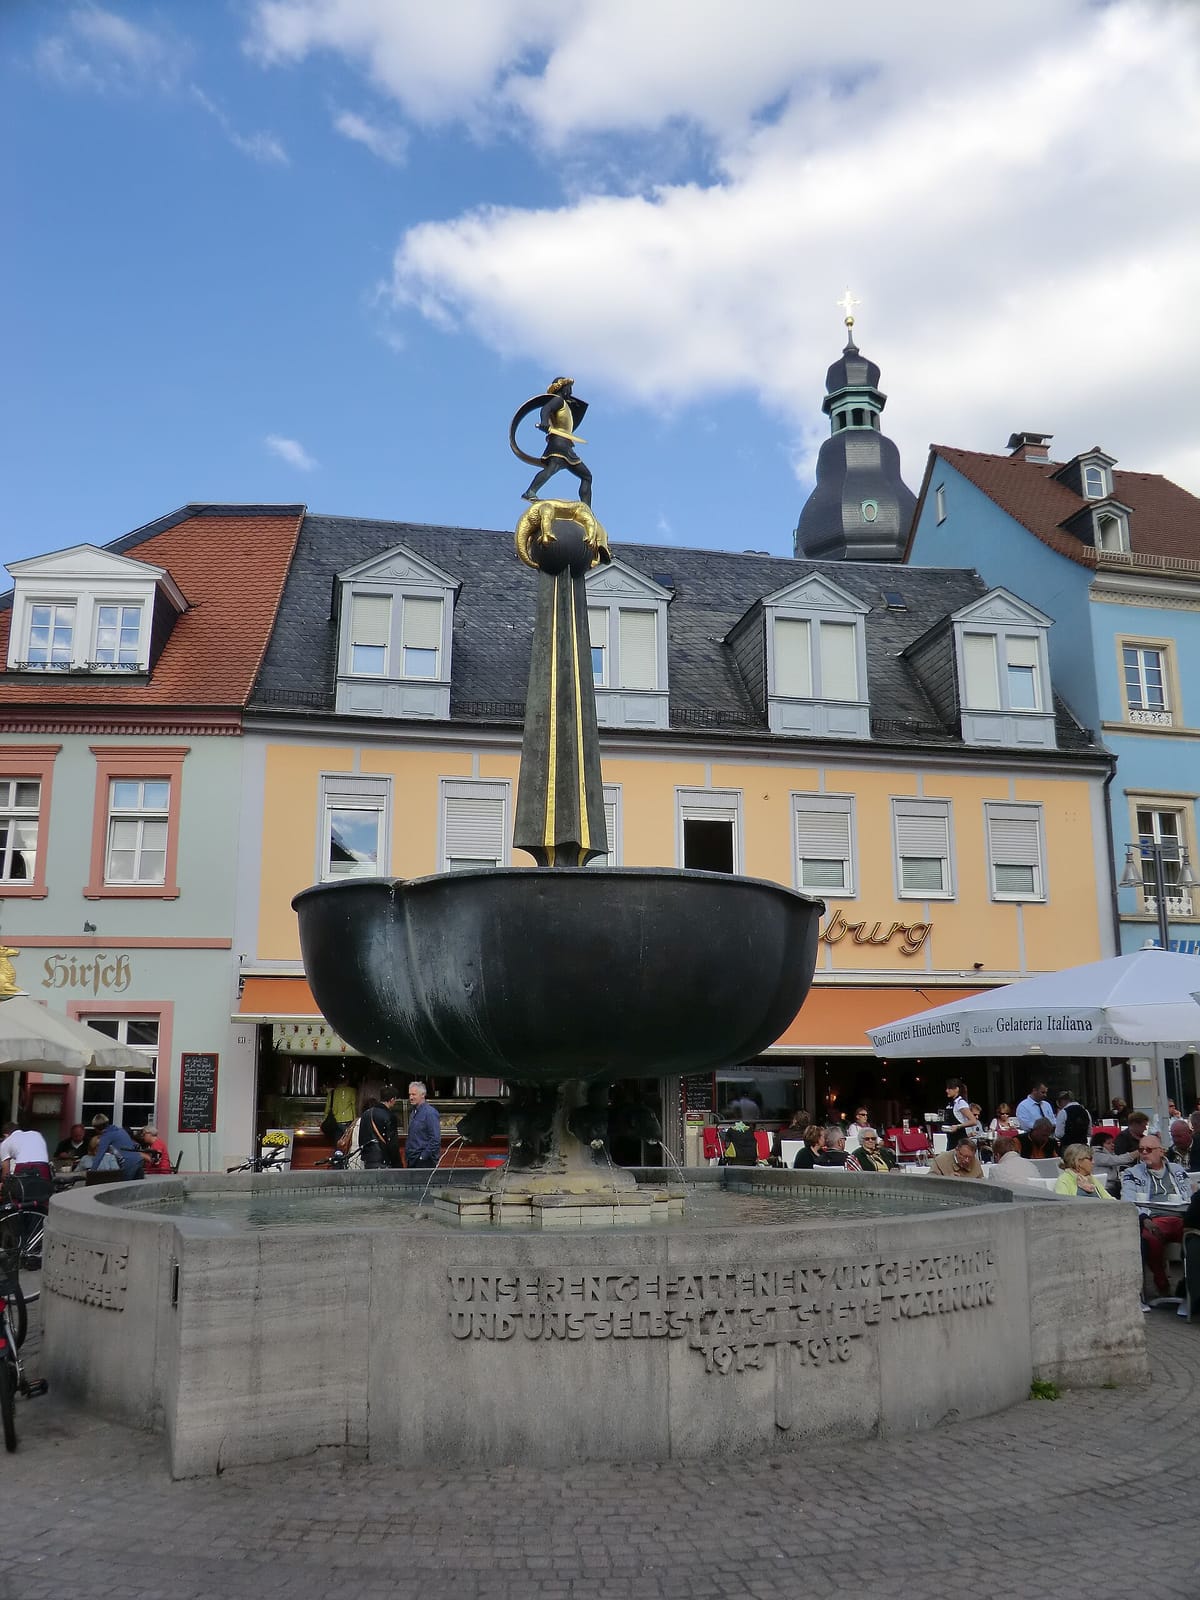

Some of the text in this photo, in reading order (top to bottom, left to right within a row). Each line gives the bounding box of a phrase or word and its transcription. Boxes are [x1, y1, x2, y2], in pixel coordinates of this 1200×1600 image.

[873, 1020, 960, 1047] Conditorei Hindenburg
[996, 1016, 1042, 1032] Gelateria
[1047, 1015, 1093, 1031] Italiana
[450, 1276, 600, 1302] UNSEREN
[450, 1313, 515, 1340] UND
[522, 1313, 586, 1340] UNS
[594, 1310, 702, 1340] SELBST
[702, 1333, 852, 1374] 1914 1918
